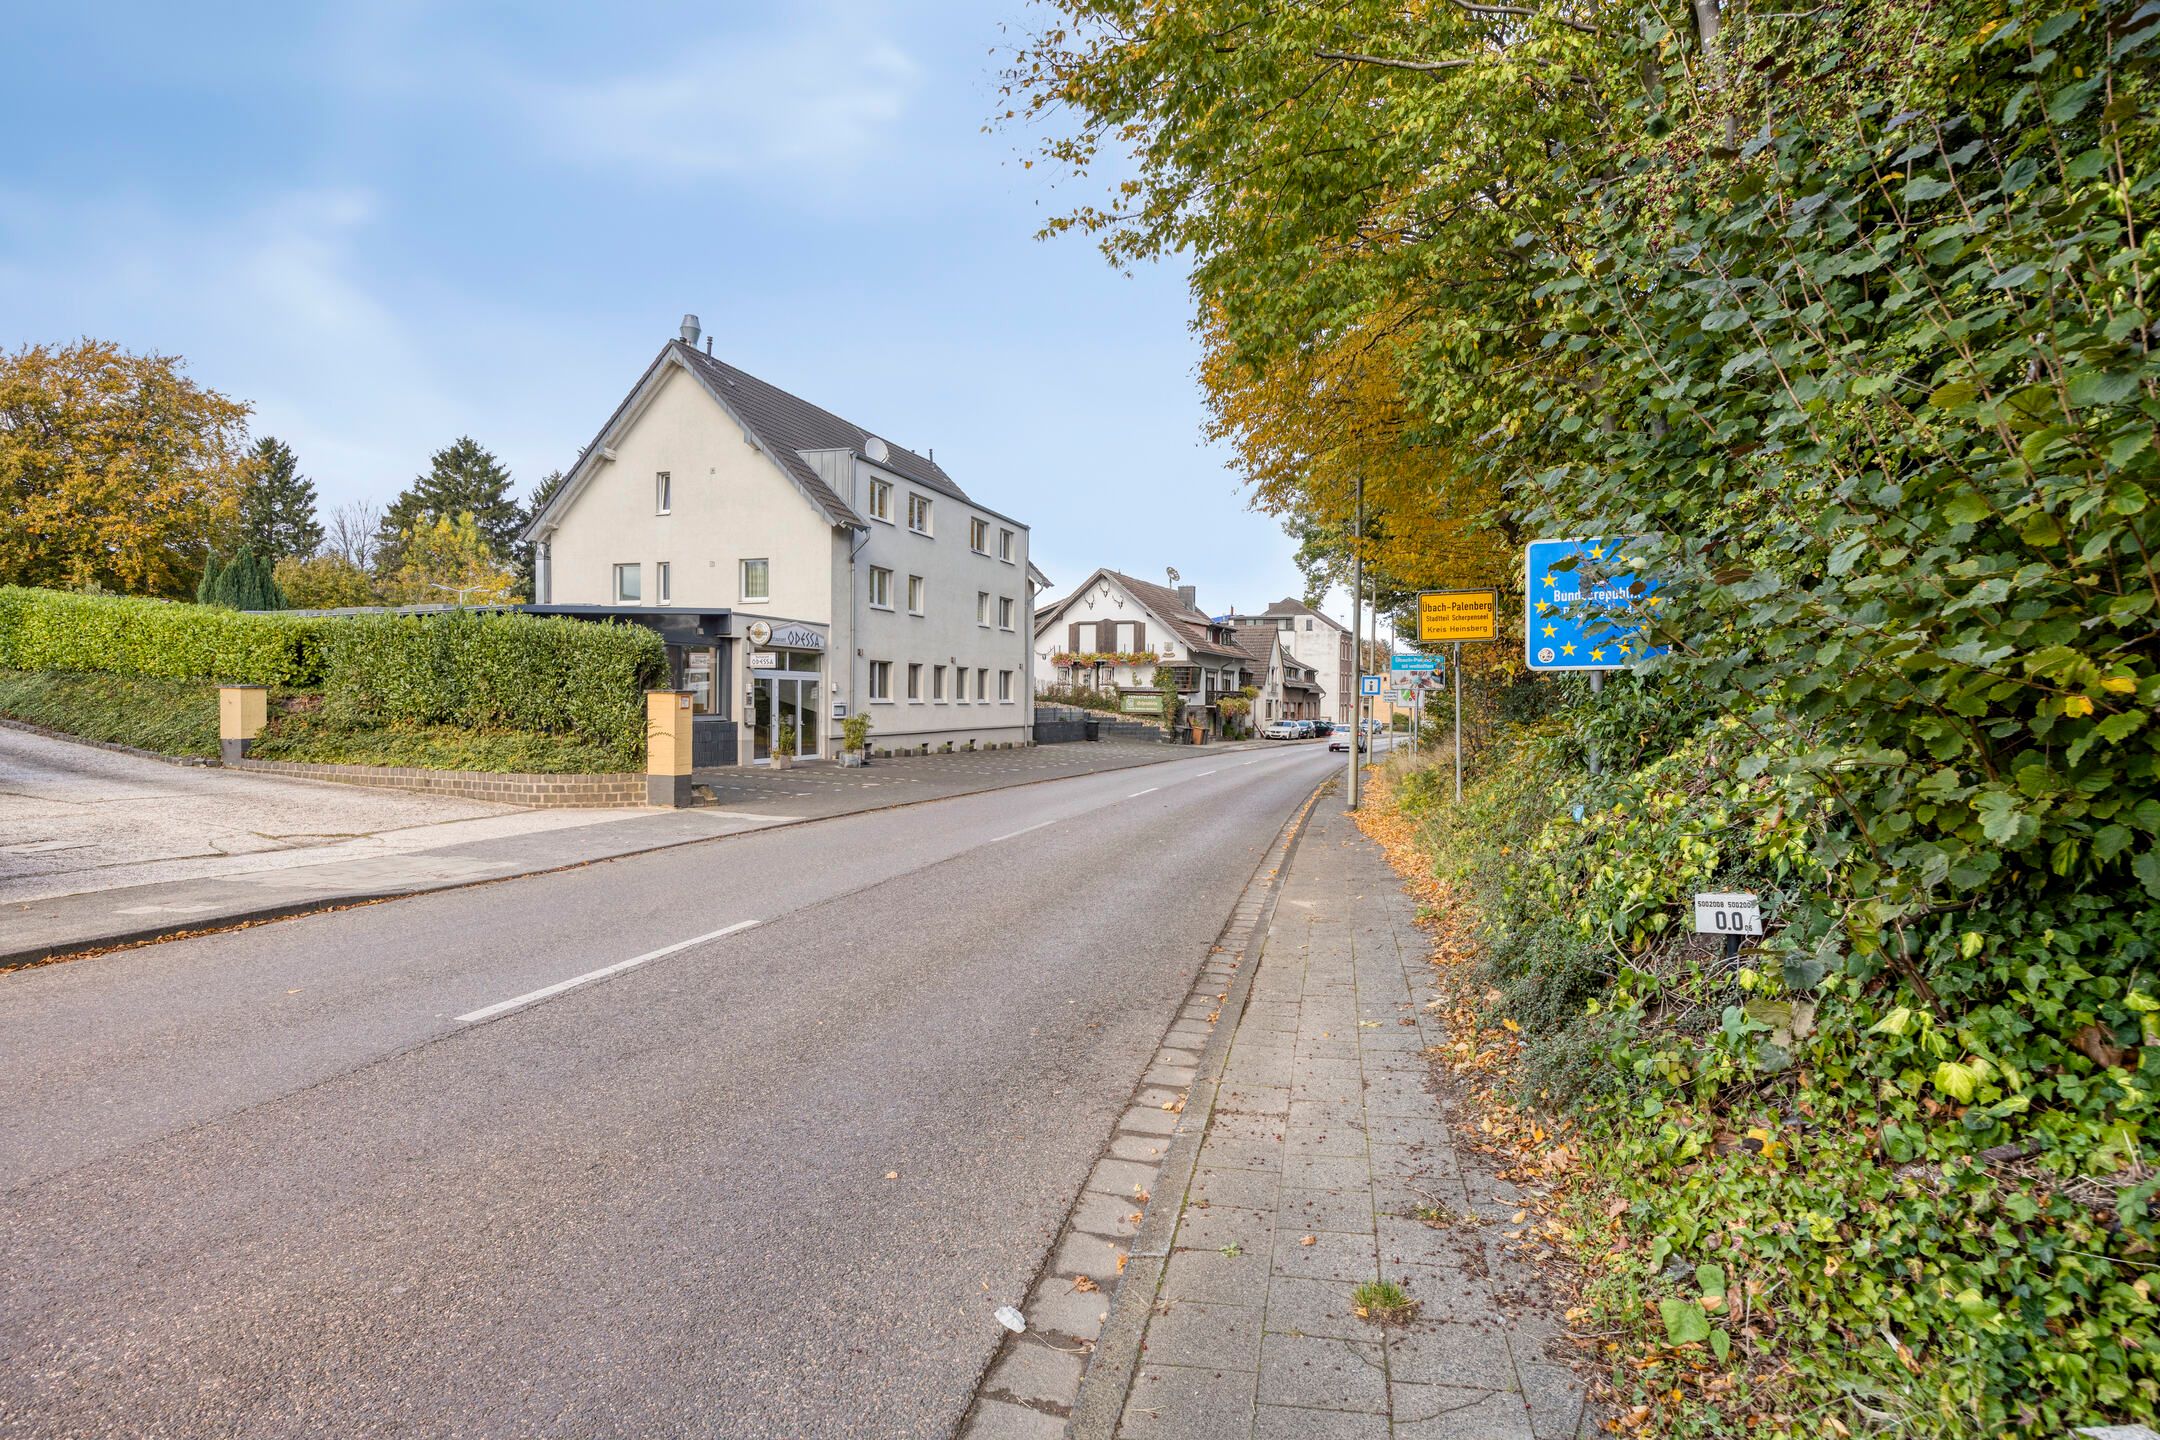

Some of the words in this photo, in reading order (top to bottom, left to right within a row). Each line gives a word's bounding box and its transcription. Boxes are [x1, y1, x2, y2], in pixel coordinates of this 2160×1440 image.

[1554, 587, 1640, 603] Bundsrepubli
[1422, 601, 1492, 612] Übach-Palenberg
[1426, 614, 1449, 622] Stadtteil
[1452, 613, 1489, 622] Scherpenseel
[787, 630, 820, 648] ODESSA
[1715, 911, 1743, 931] 0.0
